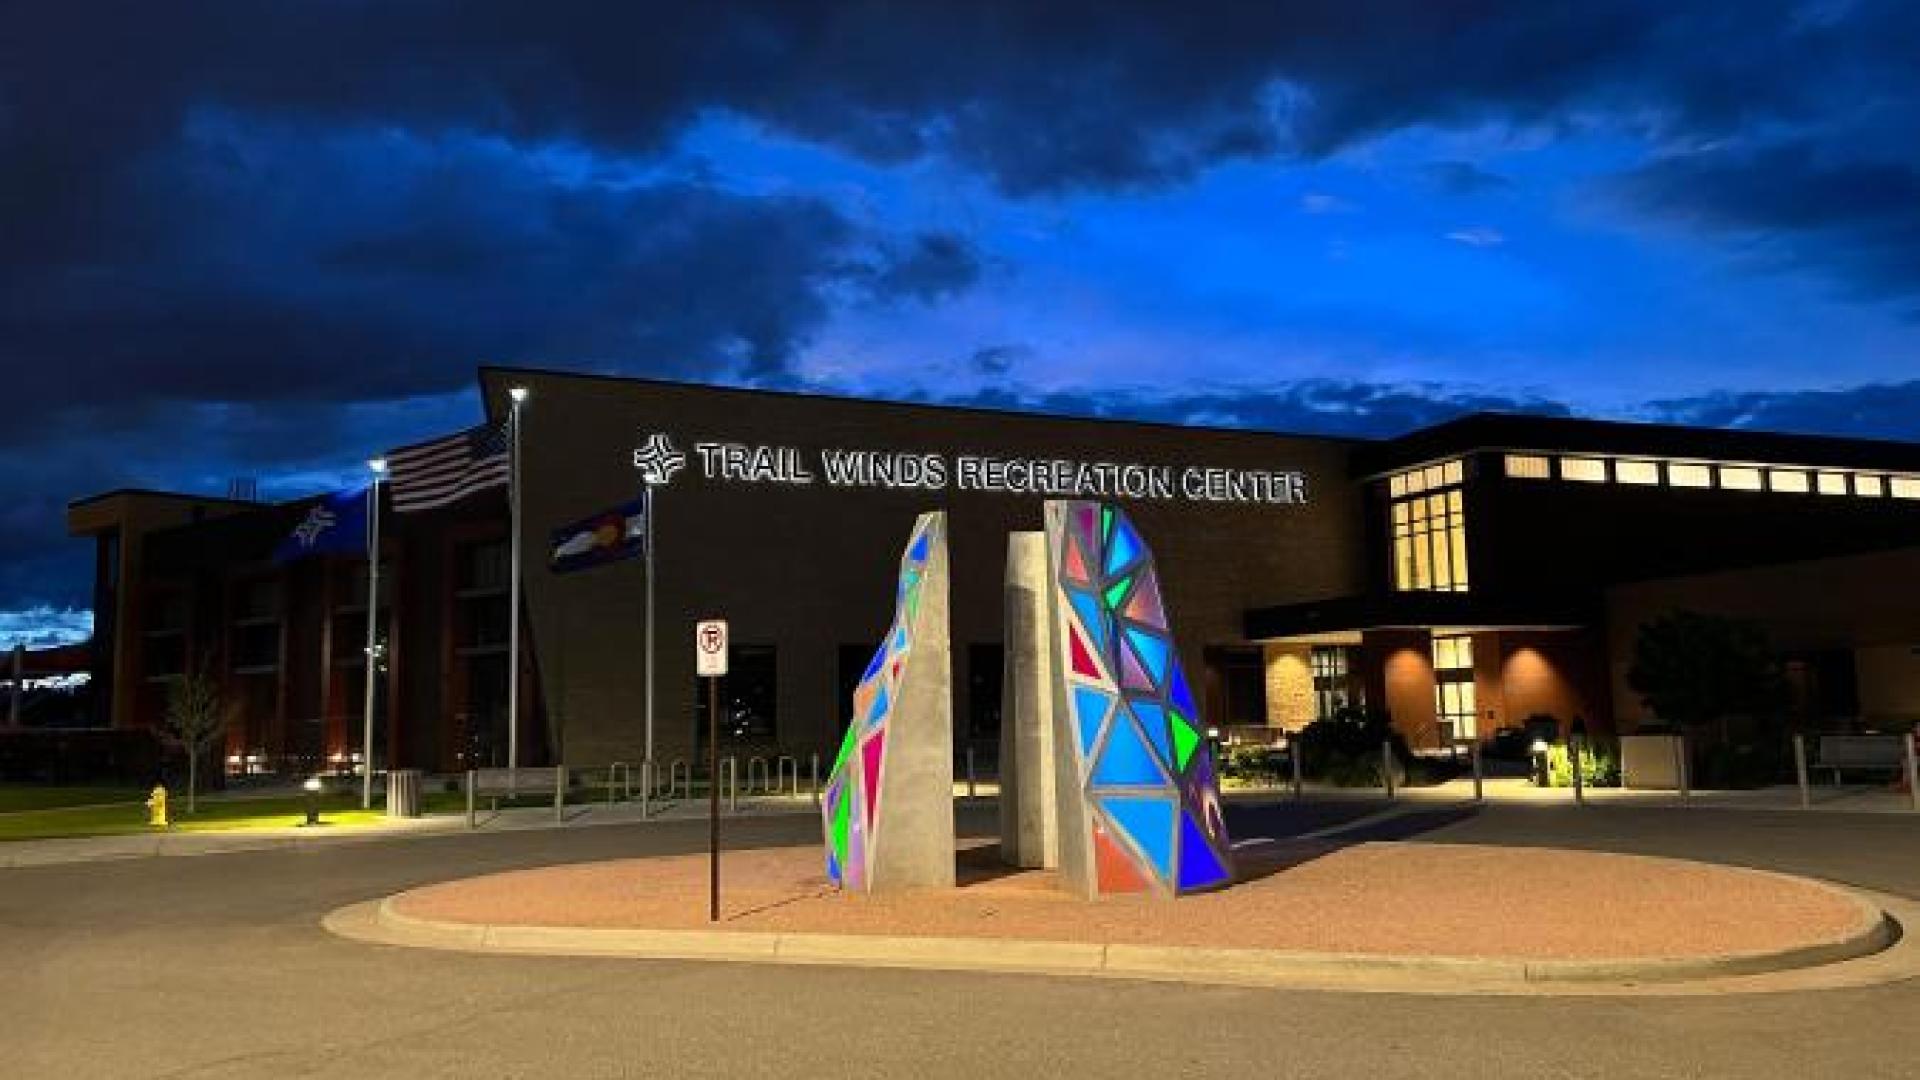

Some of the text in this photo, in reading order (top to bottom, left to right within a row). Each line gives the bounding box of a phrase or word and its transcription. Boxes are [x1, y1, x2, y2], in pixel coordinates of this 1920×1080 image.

[697, 443, 1308, 505] TRAIL WINDS RECREATION CENTER
